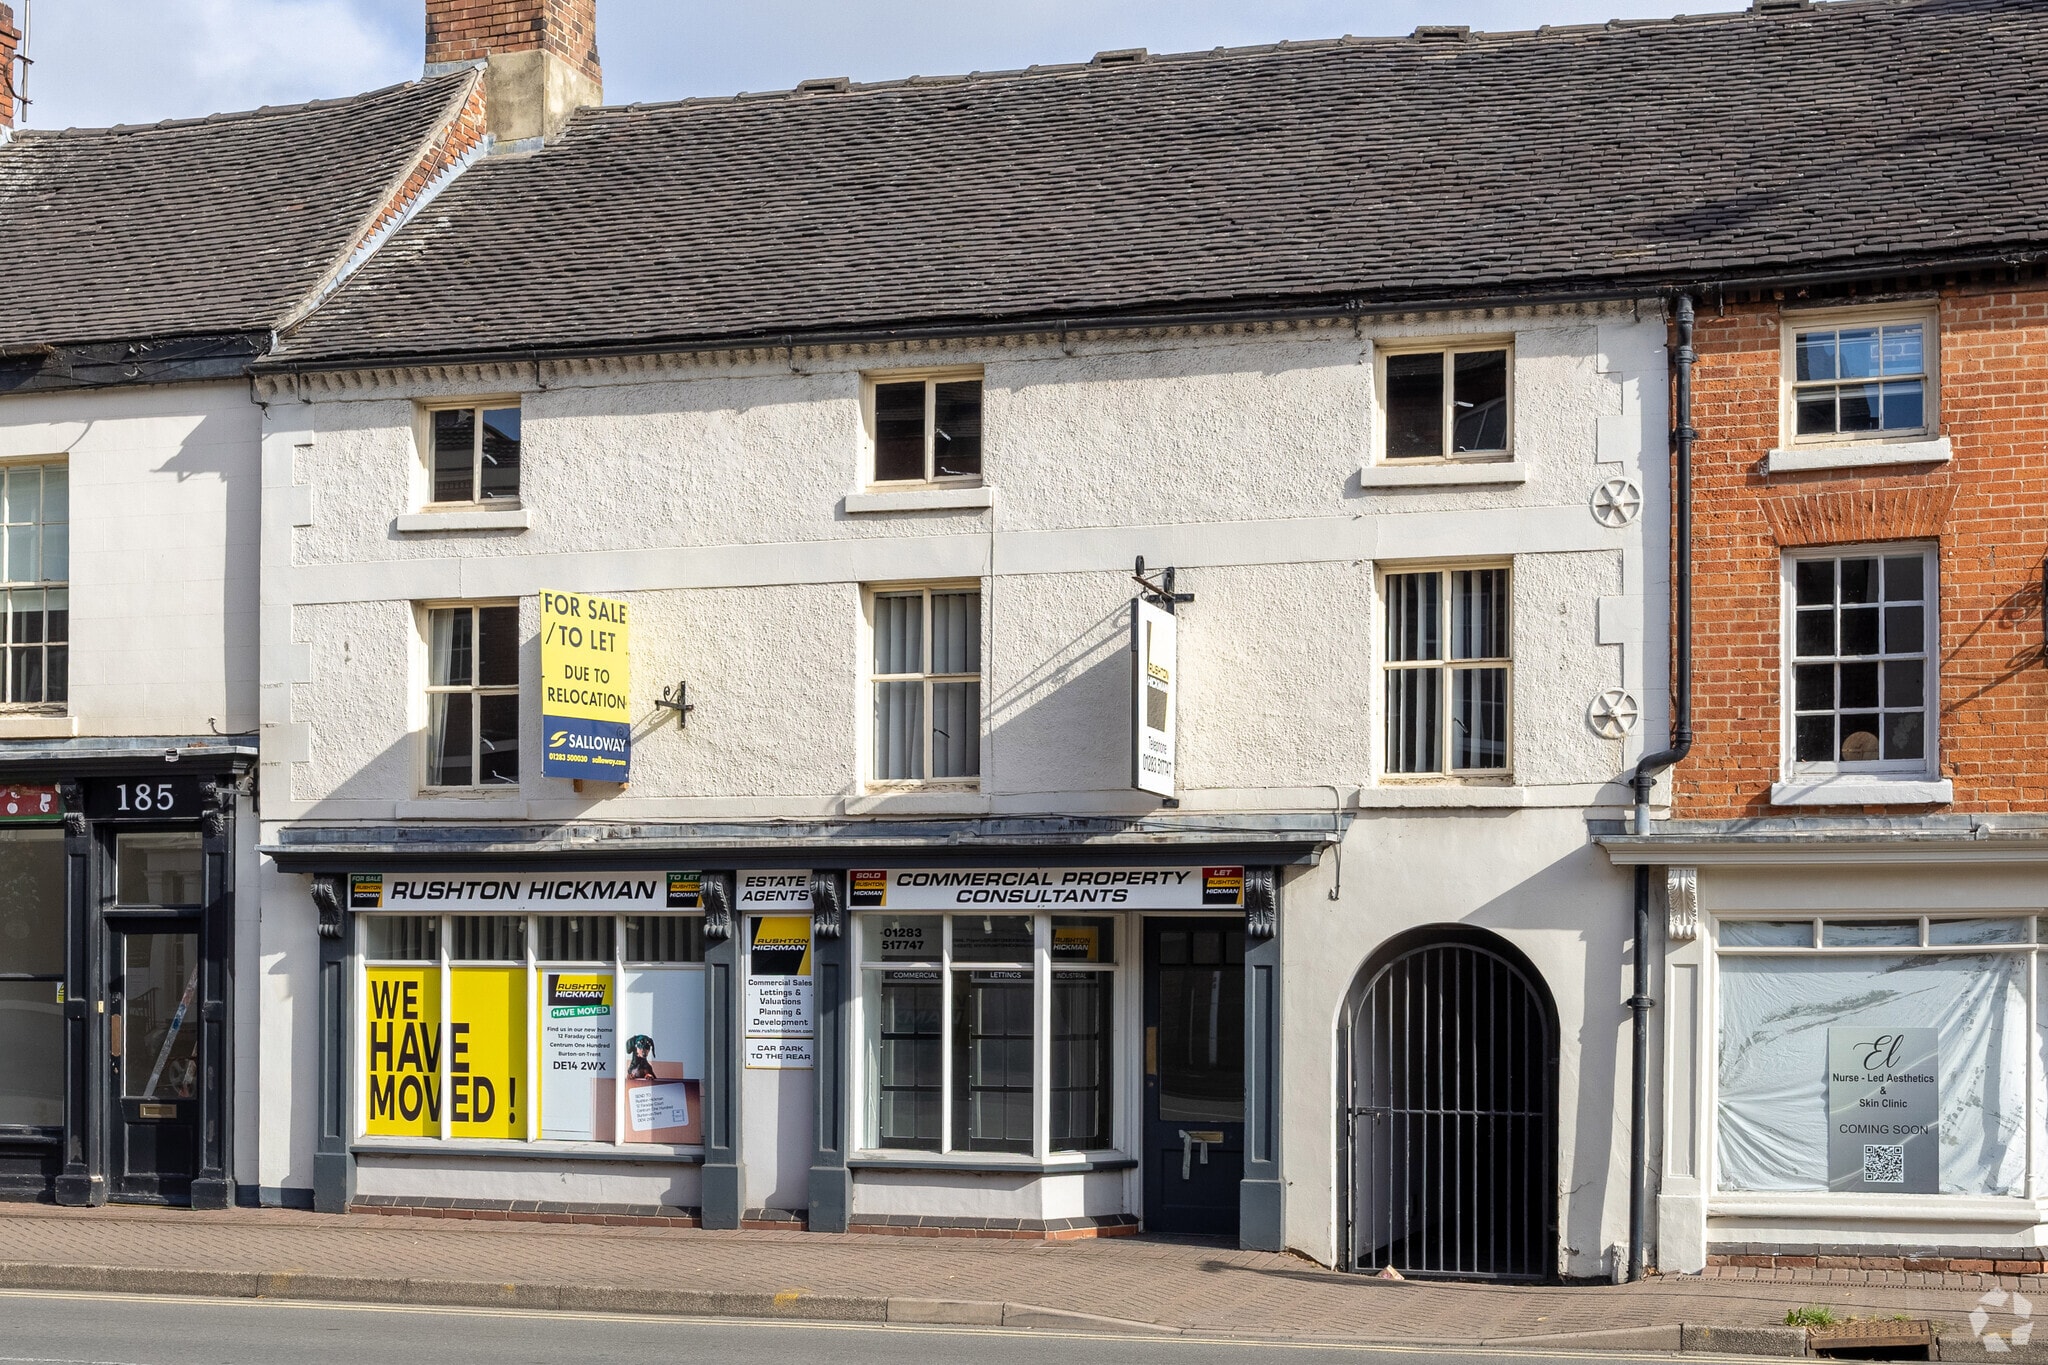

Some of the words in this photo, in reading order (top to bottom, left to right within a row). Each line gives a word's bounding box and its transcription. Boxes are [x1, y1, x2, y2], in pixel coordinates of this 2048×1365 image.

[544, 592, 581, 617] FOR
[588, 600, 626, 624] SALE
[590, 630, 615, 652] LET
[565, 664, 589, 681] DUE
[594, 668, 610, 684] TO
[548, 686, 626, 710] RELOCATION
[568, 734, 626, 752] SALLOWAY
[549, 752, 566, 761] 01283
[592, 756, 626, 766] salloway.com
[116, 784, 174, 811] 185
[745, 876, 806, 887] ESTATE
[896, 872, 1053, 886] COMMERCIAL
[1061, 871, 1191, 886] PROPERTY
[391, 881, 521, 900] RUSHTON
[528, 880, 657, 900] HICKMAN
[742, 890, 809, 901] AGENTS
[956, 889, 1128, 903] CONSULTANTS
[884, 928, 922, 937] 01283
[882, 940, 924, 950] 517747
[371, 981, 418, 1019] WE
[760, 989, 792, 997] Lettings
[577, 1006, 608, 1016] MOVED
[759, 1008, 792, 1017] Planning
[753, 1018, 808, 1027] Development
[371, 1022, 470, 1073] HAVE
[1853, 1034, 1904, 1070] El
[553, 1061, 578, 1070] DE14
[580, 1062, 606, 1070] 2WX
[1832, 1073, 1859, 1082] Nurse
[1867, 1074, 1884, 1082] Led
[1886, 1074, 1934, 1083] Aesthetics
[1880, 1086, 1887, 1094] &
[370, 1074, 495, 1122] MOVED
[1859, 1099, 1879, 1107] Skin
[1882, 1099, 1908, 1108] Clinic
[1840, 1124, 1889, 1134] COMING
[1893, 1125, 1928, 1134] SOON
